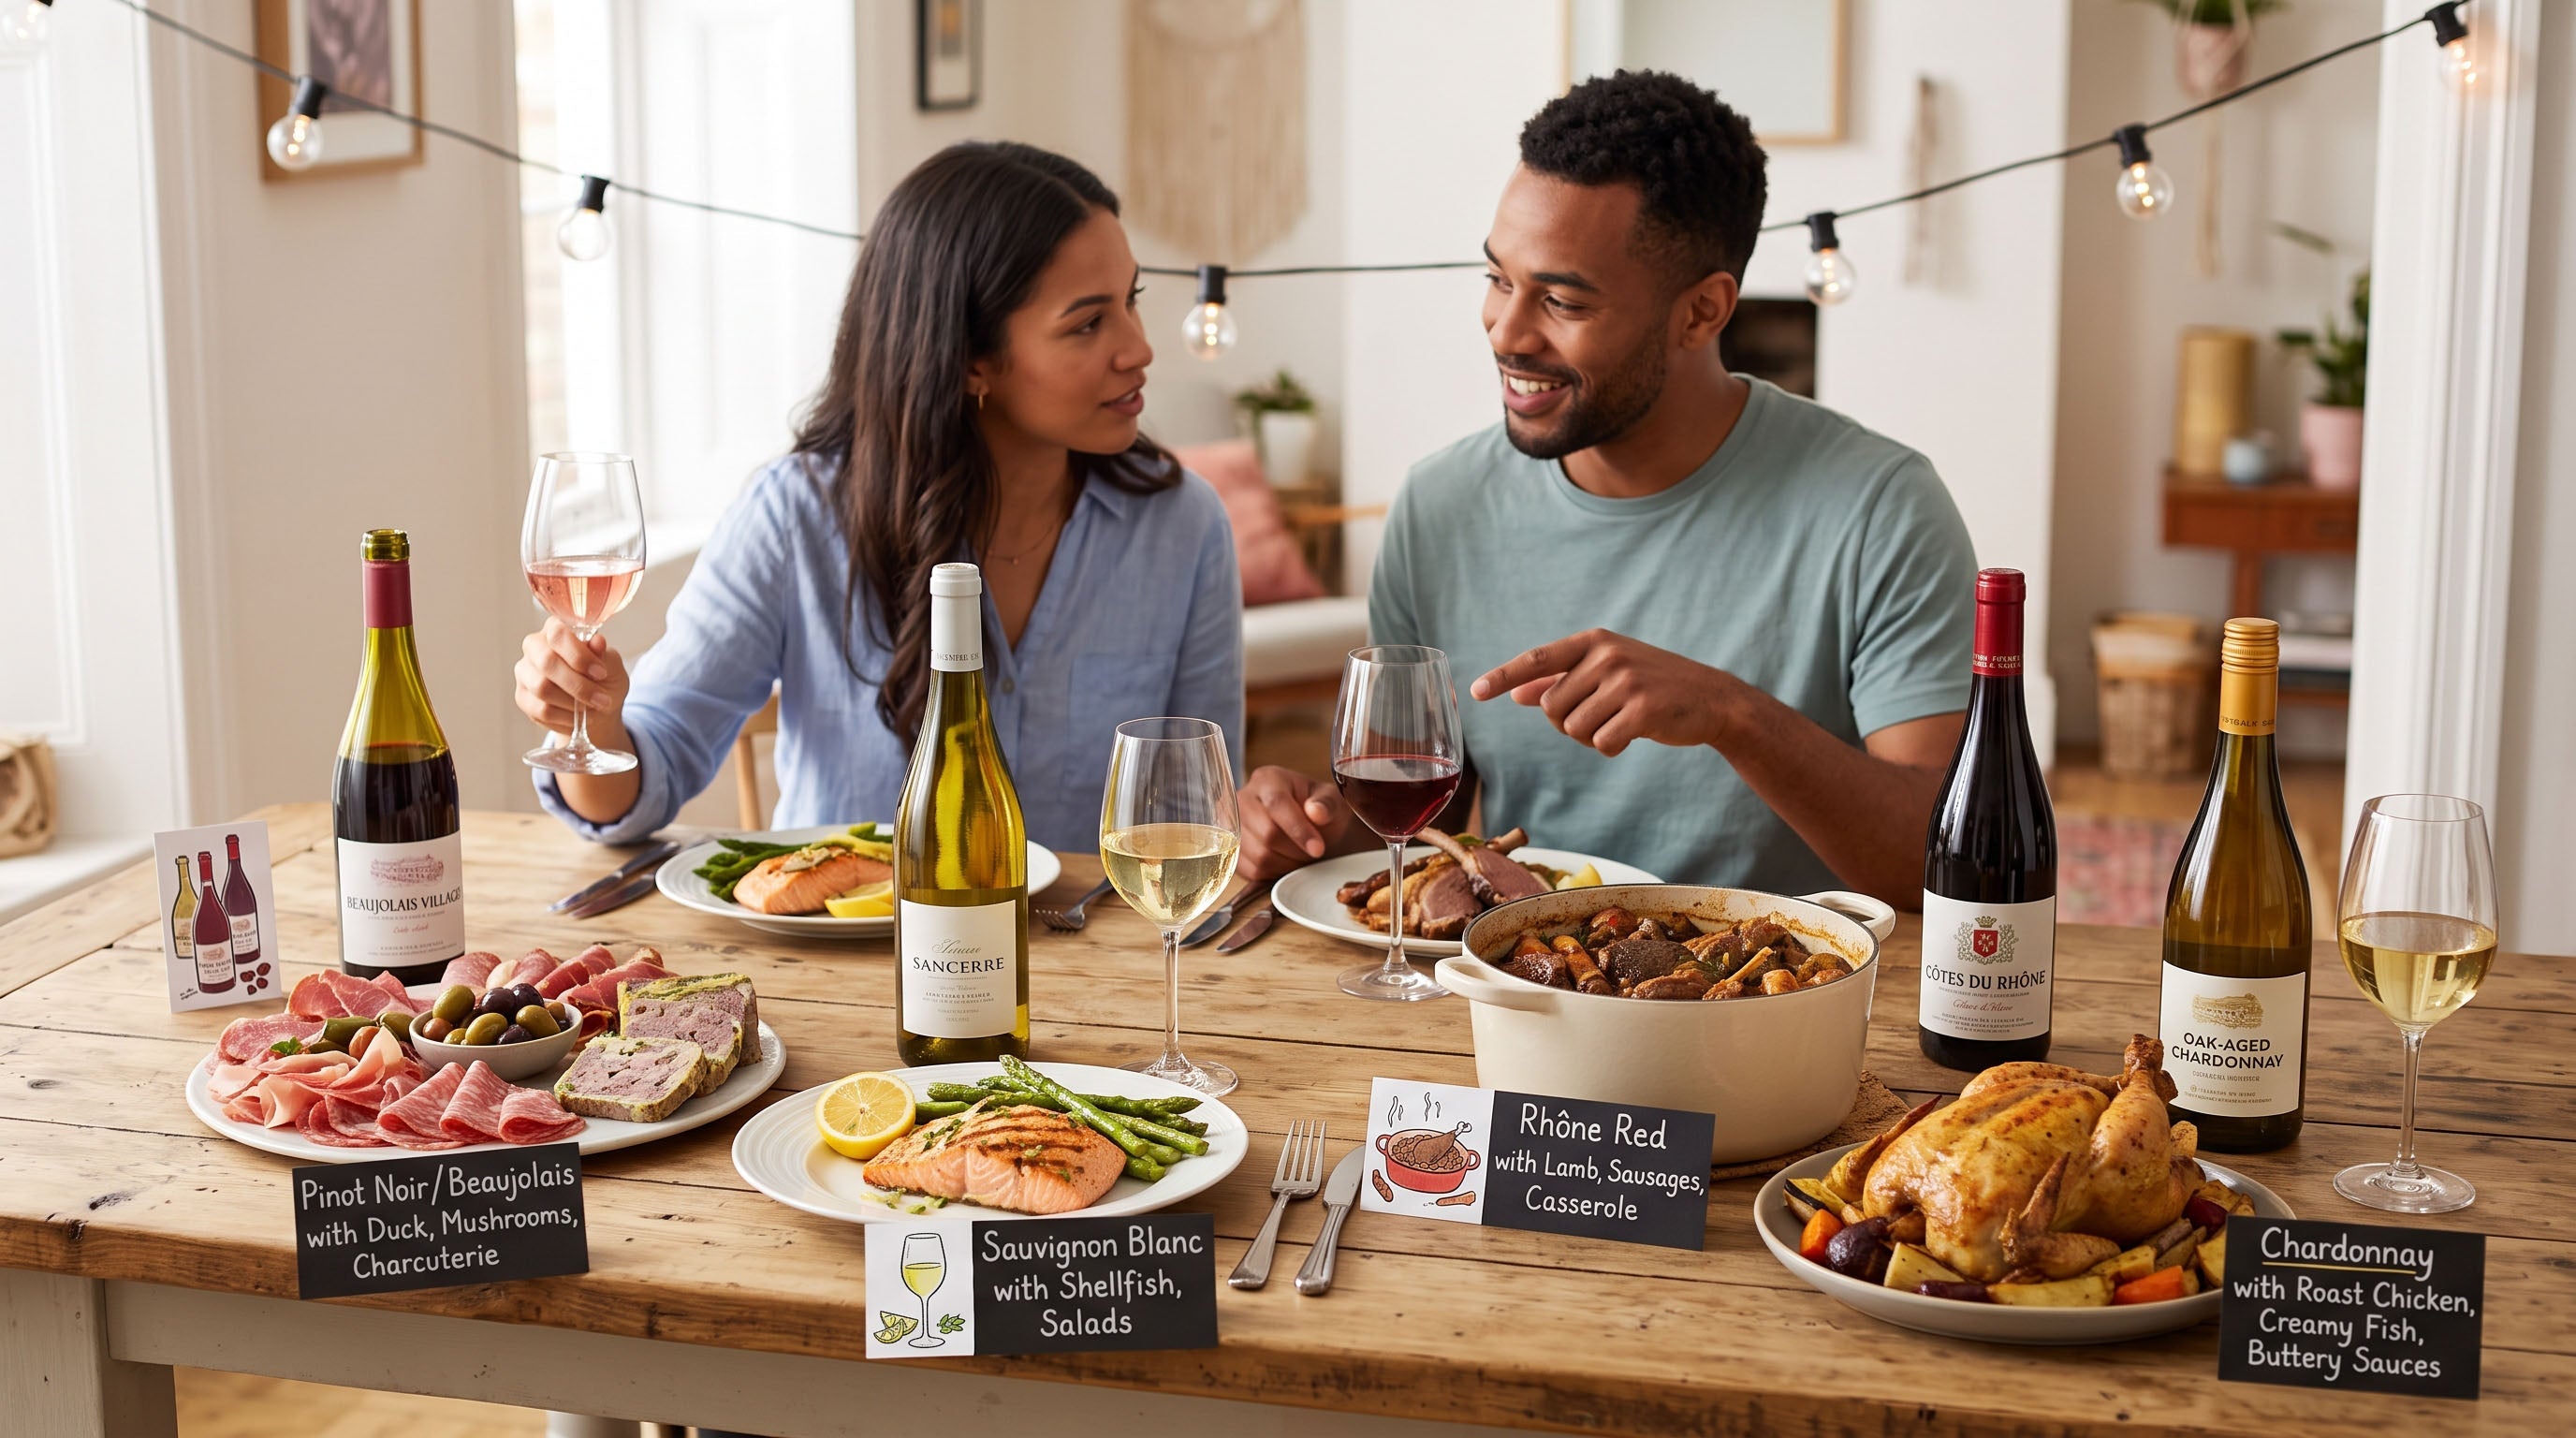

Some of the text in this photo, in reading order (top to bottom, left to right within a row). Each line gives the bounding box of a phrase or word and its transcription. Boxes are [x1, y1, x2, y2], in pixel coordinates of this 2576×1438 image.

[346, 896, 417, 915] BEAUJOLAIS
[913, 956, 1004, 974] SANCERRE
[1925, 964, 2046, 990] CÔTES DU RHÔNE
[2172, 1045, 2284, 1069] CHARDONNAY
[2183, 1032, 2271, 1052] OAK-AGED
[1519, 1102, 1667, 1150] Rhône Red
[1495, 1149, 1705, 1198] with Lamb, Sausages,
[300, 1178, 366, 1211] Pinot
[1525, 1184, 1638, 1221] Casserole
[306, 1207, 578, 1249] with Duck, Mushrooms,
[353, 1244, 501, 1279] Charcuterie
[982, 1225, 1204, 1269] Sauvignon Blanc
[2261, 1226, 2434, 1282] Chardonnay
[993, 1268, 1182, 1303] with Shellfish,
[2233, 1275, 2475, 1317] with Roast Chicken,
[1040, 1307, 1133, 1338] Salads
[2259, 1307, 2424, 1348] Creamy Fish,
[2247, 1339, 2441, 1381] Buttery Sauces
